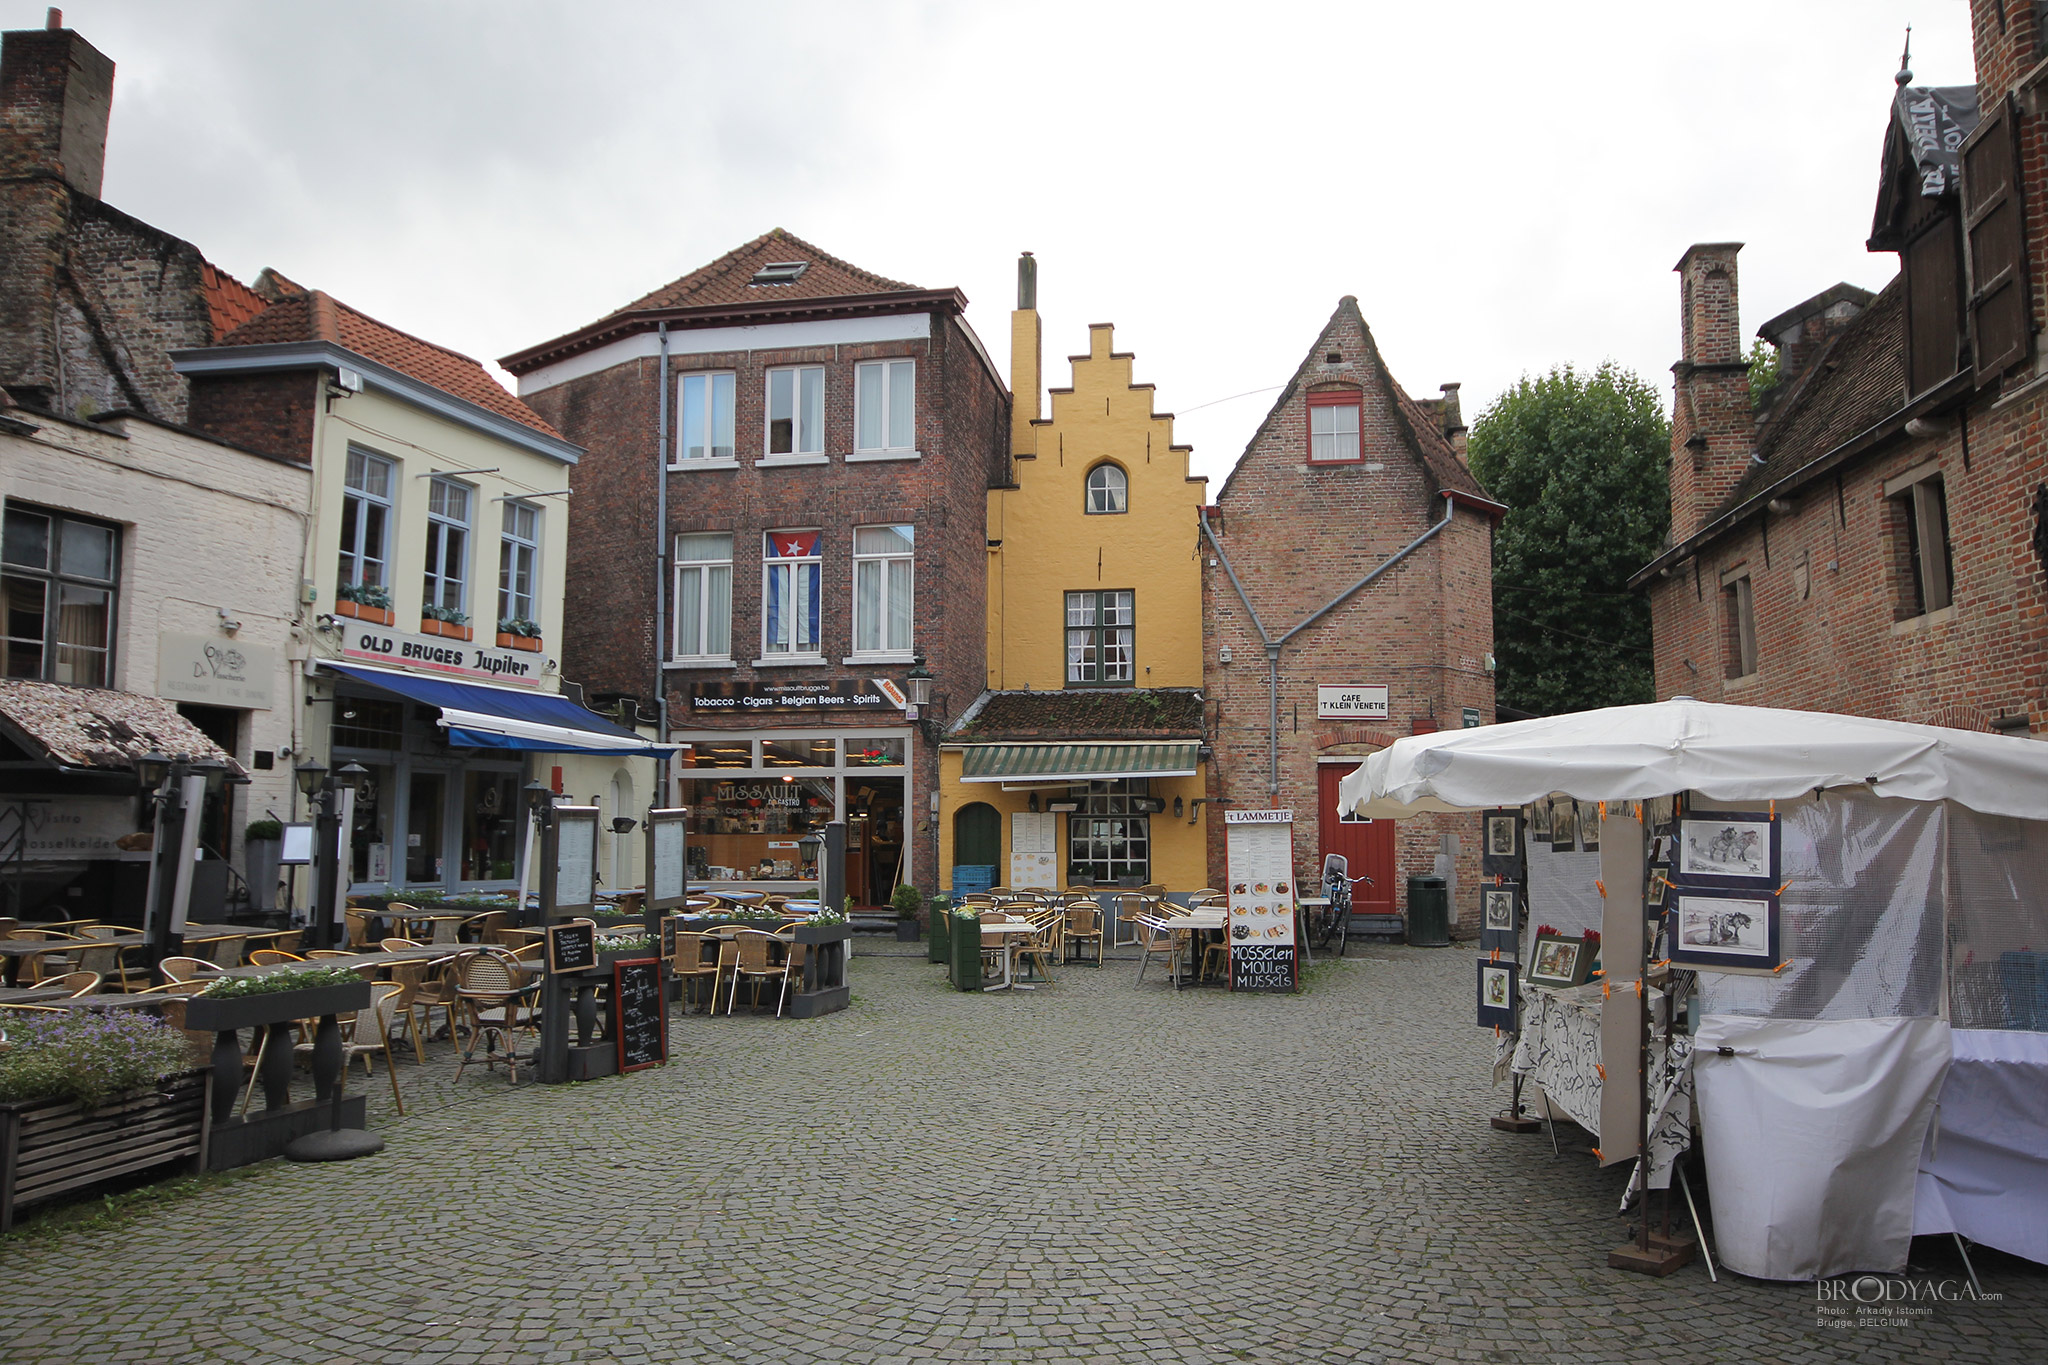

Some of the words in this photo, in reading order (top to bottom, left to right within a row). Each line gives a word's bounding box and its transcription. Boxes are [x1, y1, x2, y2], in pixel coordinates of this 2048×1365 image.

[360, 634, 393, 653] OLD
[401, 641, 463, 665] BRUGES
[473, 651, 529, 676] Jupiler
[883, 681, 904, 704] Habanos
[1341, 694, 1361, 702] CAFE
[694, 697, 735, 706] Tobacco
[743, 696, 773, 708] Cigars
[781, 695, 817, 707] Belgian
[819, 695, 845, 705] Beers
[853, 694, 881, 706] Spirits
[1354, 702, 1386, 710] VENETIE
[717, 785, 802, 801] MISSAULT
[1237, 811, 1290, 822] LAMMETJE
[1231, 945, 1293, 960] MOSSelen
[1241, 961, 1288, 974] MOULes
[1237, 974, 1292, 987] MUSSels
